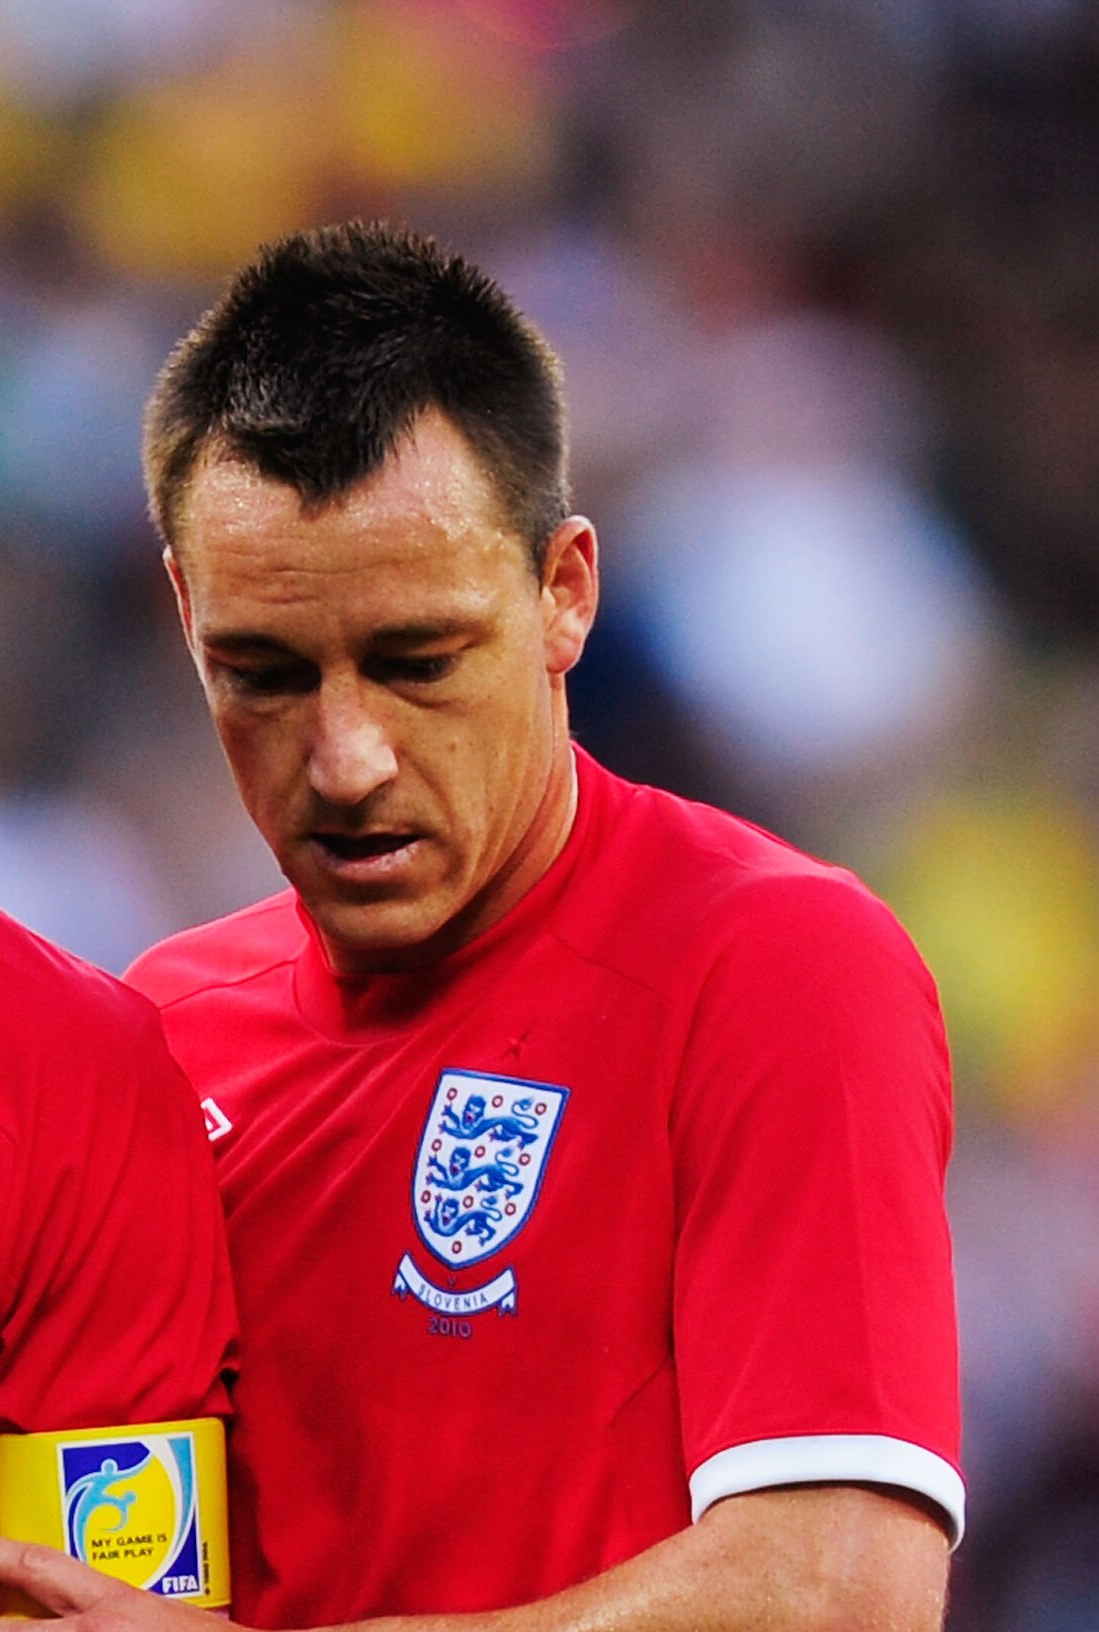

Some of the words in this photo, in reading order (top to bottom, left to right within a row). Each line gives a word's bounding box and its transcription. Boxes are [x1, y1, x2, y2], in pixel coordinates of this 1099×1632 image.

[418, 1284, 488, 1311] SLOVENIA
[428, 1316, 472, 1339] 2010
[91, 1539, 111, 1548] MY
[116, 1534, 152, 1546] GAME
[157, 1533, 167, 1542] IS
[92, 1550, 119, 1560] FAIR
[124, 1547, 153, 1558] PLAY
[162, 1575, 198, 1593] FIFA
